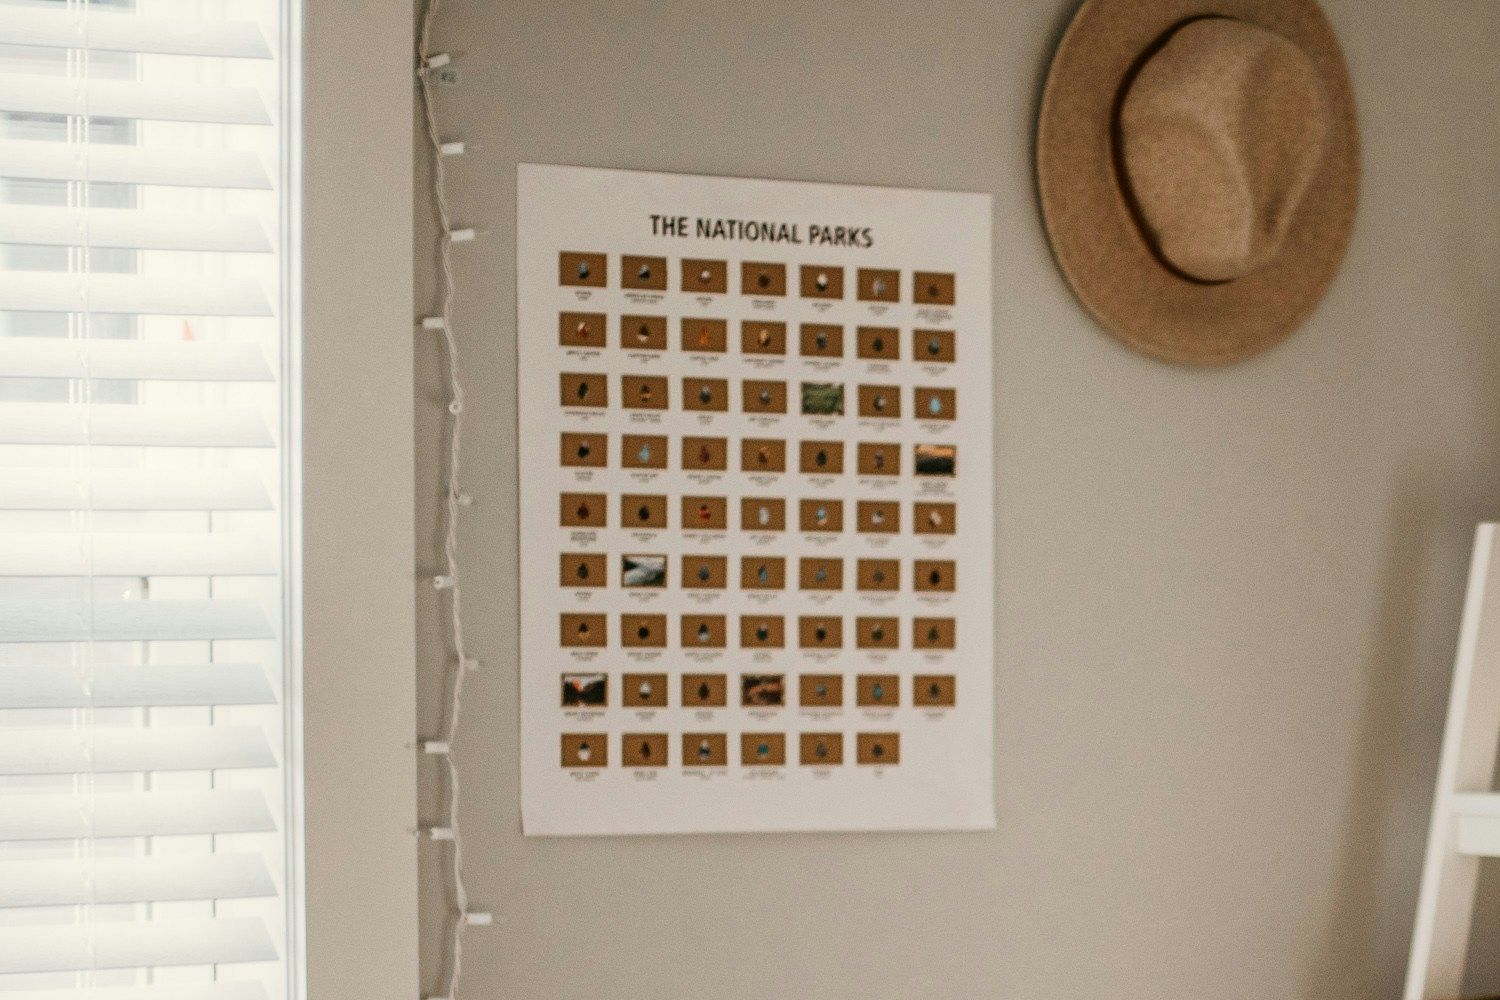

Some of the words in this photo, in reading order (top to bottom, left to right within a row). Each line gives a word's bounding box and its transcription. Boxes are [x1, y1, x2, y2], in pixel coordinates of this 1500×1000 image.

[650, 214, 688, 238] THE
[697, 217, 802, 245] NATIONAL
[808, 224, 873, 249] PARKS
